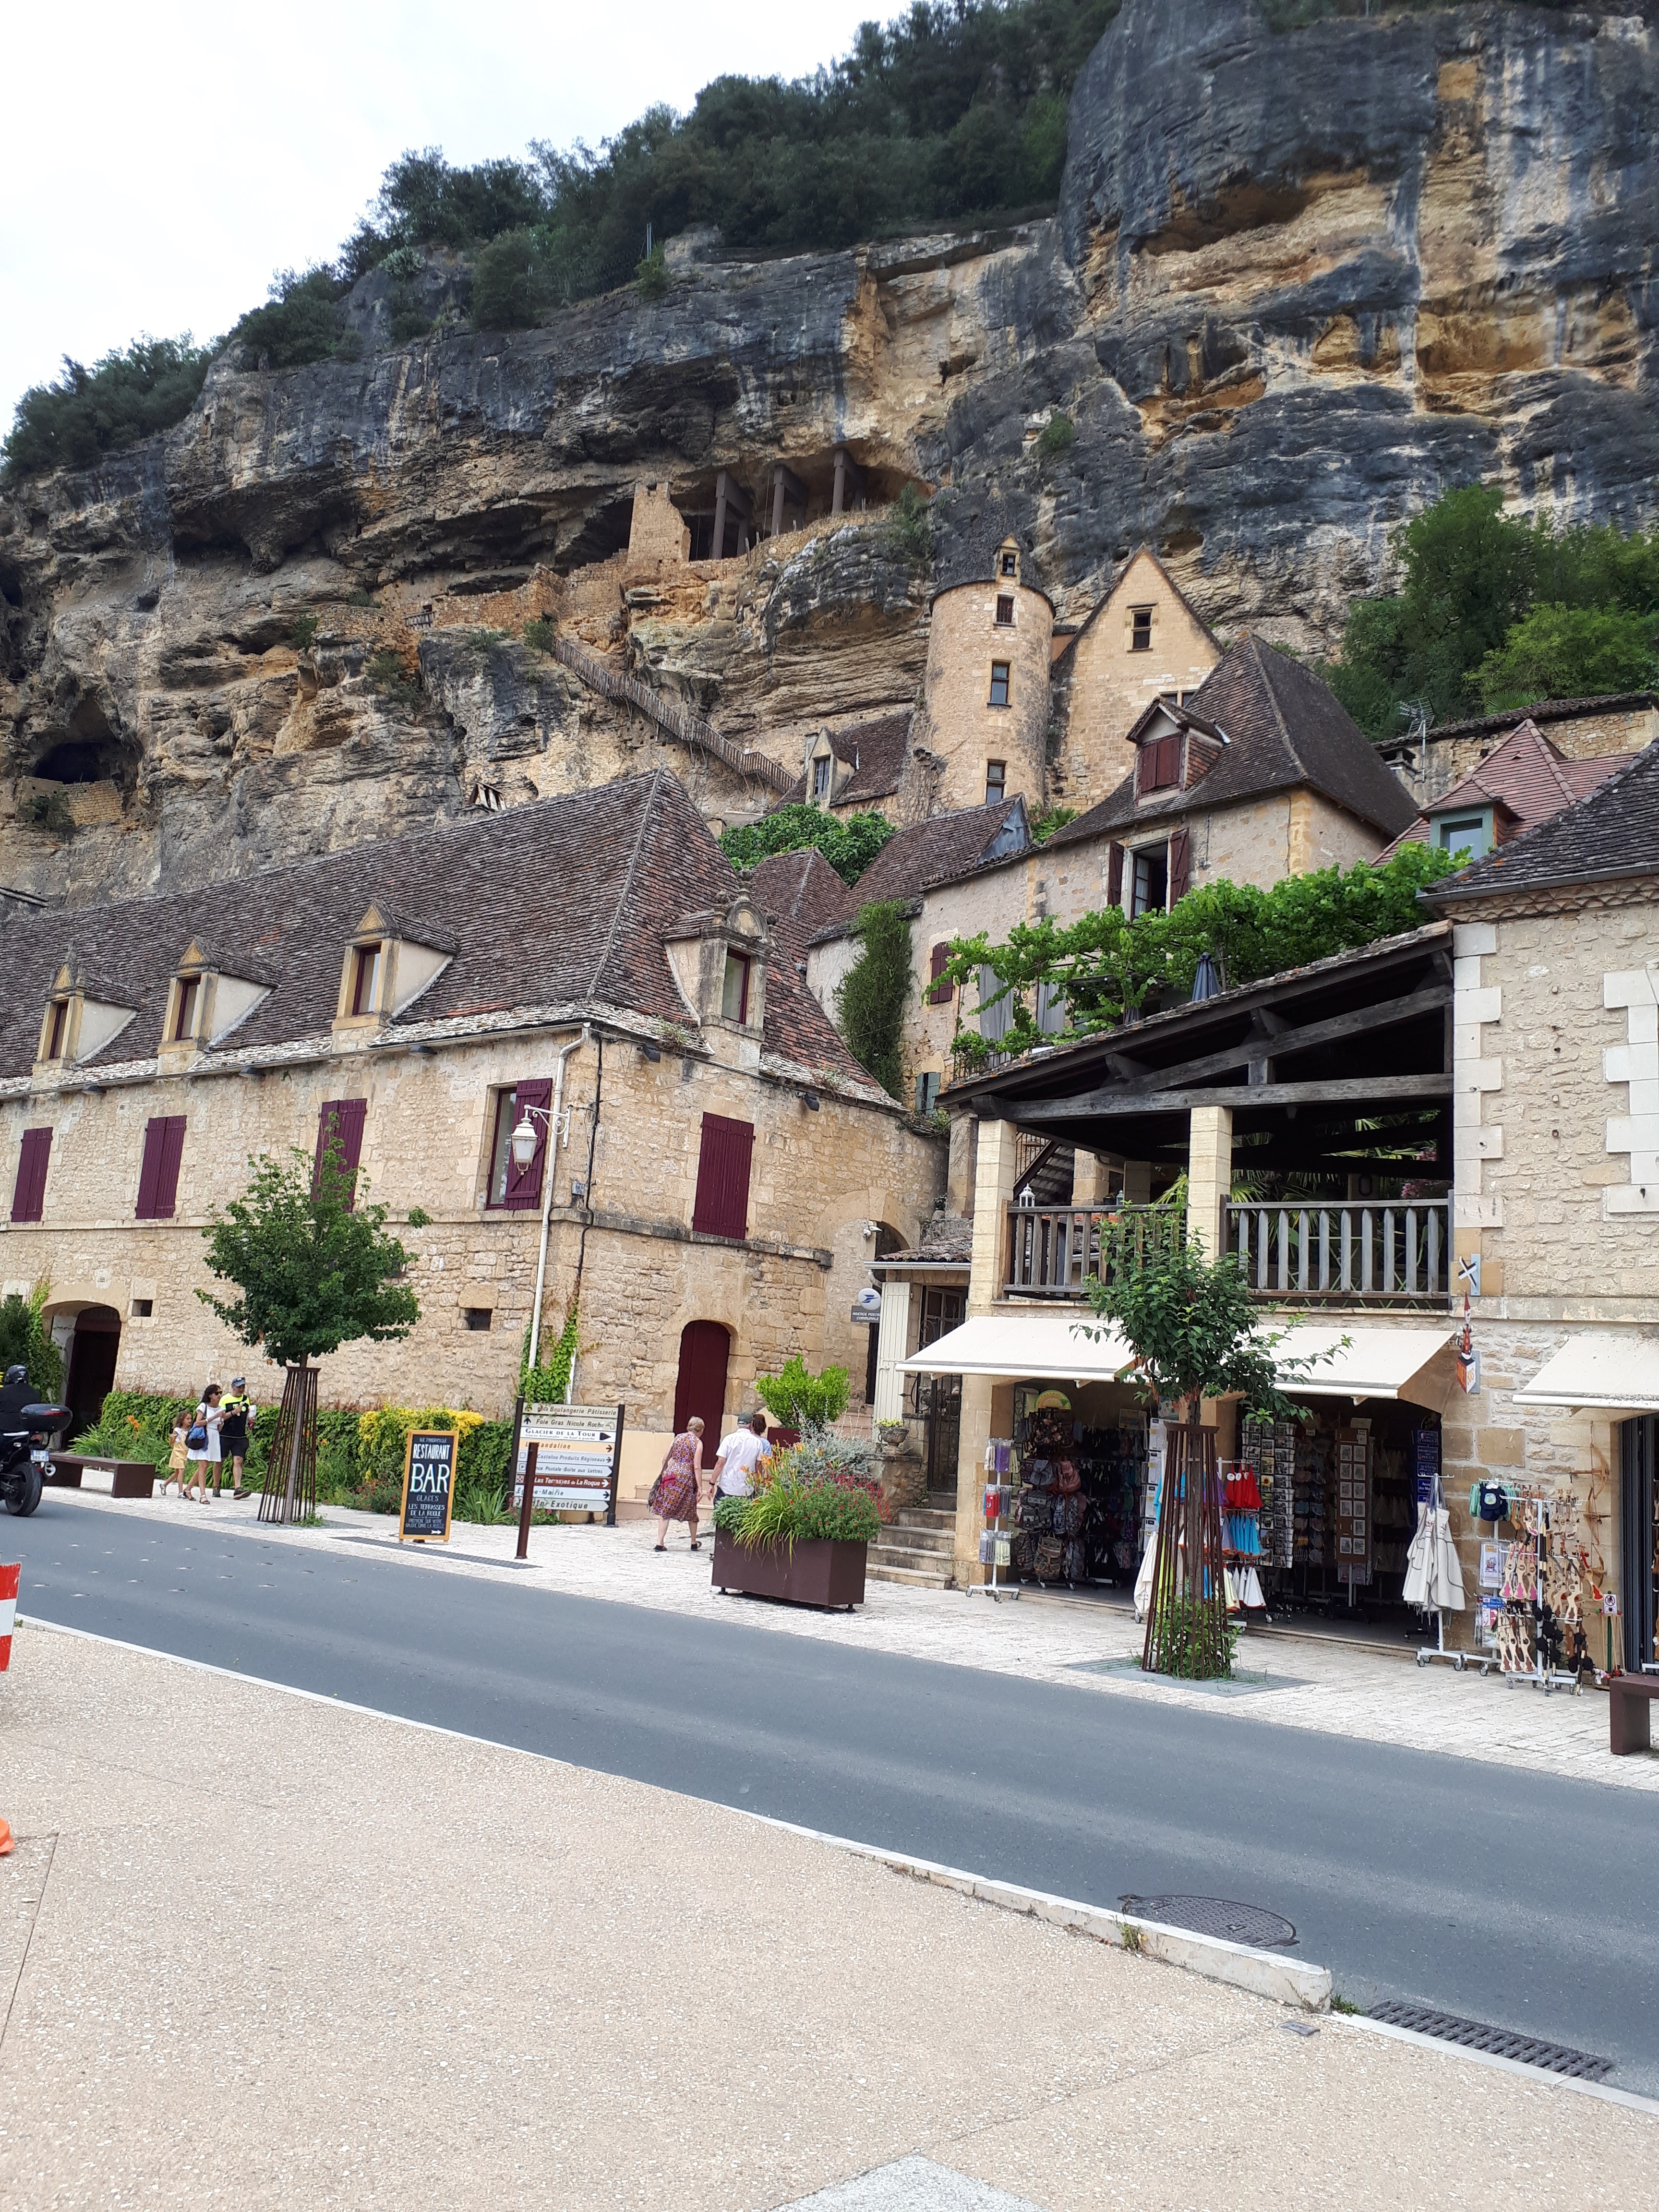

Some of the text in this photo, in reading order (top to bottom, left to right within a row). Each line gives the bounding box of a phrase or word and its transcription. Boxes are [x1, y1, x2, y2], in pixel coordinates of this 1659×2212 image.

[550, 1407, 584, 1415] Boulangerie
[413, 1443, 451, 1460] RESTAURANT
[409, 1463, 450, 1494] BAR
[584, 1479, 601, 1487] Roque
[551, 1500, 588, 1510] Exotique
